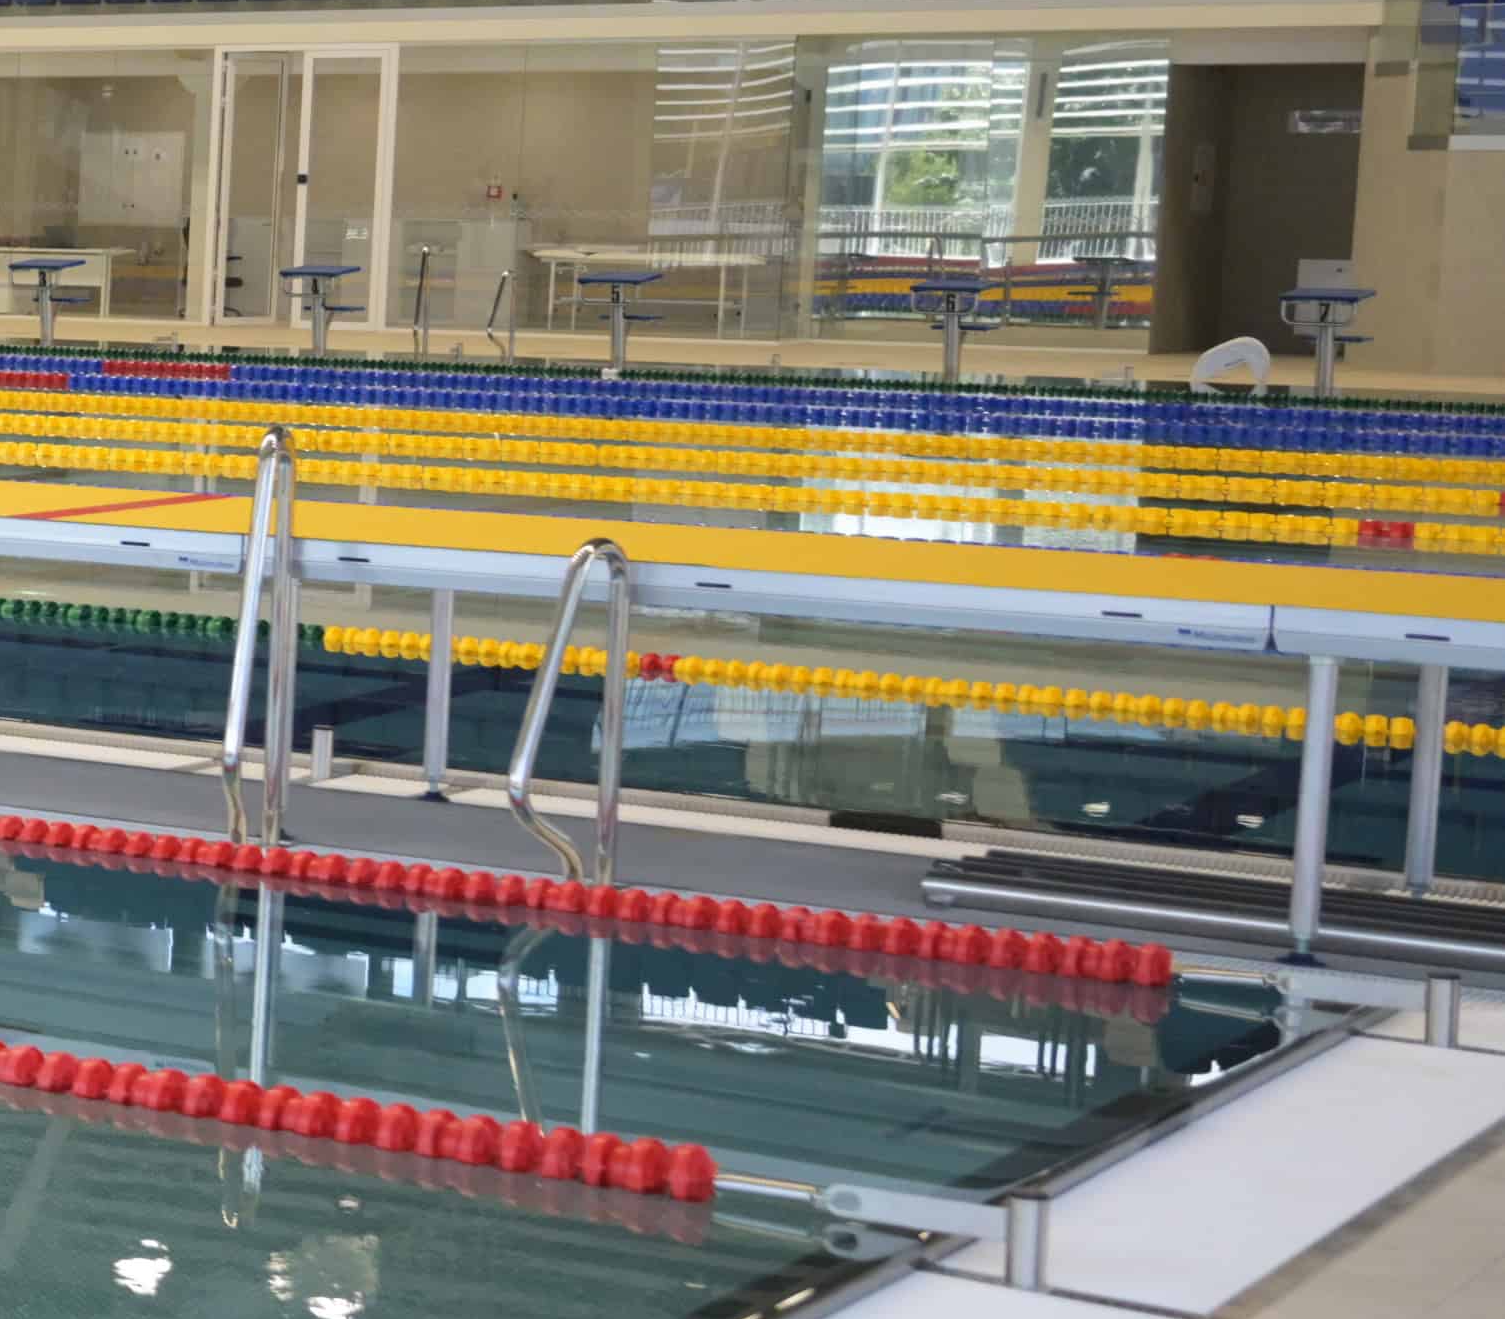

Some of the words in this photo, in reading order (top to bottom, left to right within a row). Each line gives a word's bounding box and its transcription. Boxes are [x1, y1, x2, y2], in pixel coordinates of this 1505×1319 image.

[38, 270, 47, 287] 3
[311, 277, 320, 295] 4
[611, 283, 621, 303] 5
[946, 293, 957, 313] 6
[1318, 302, 1331, 323] 7
